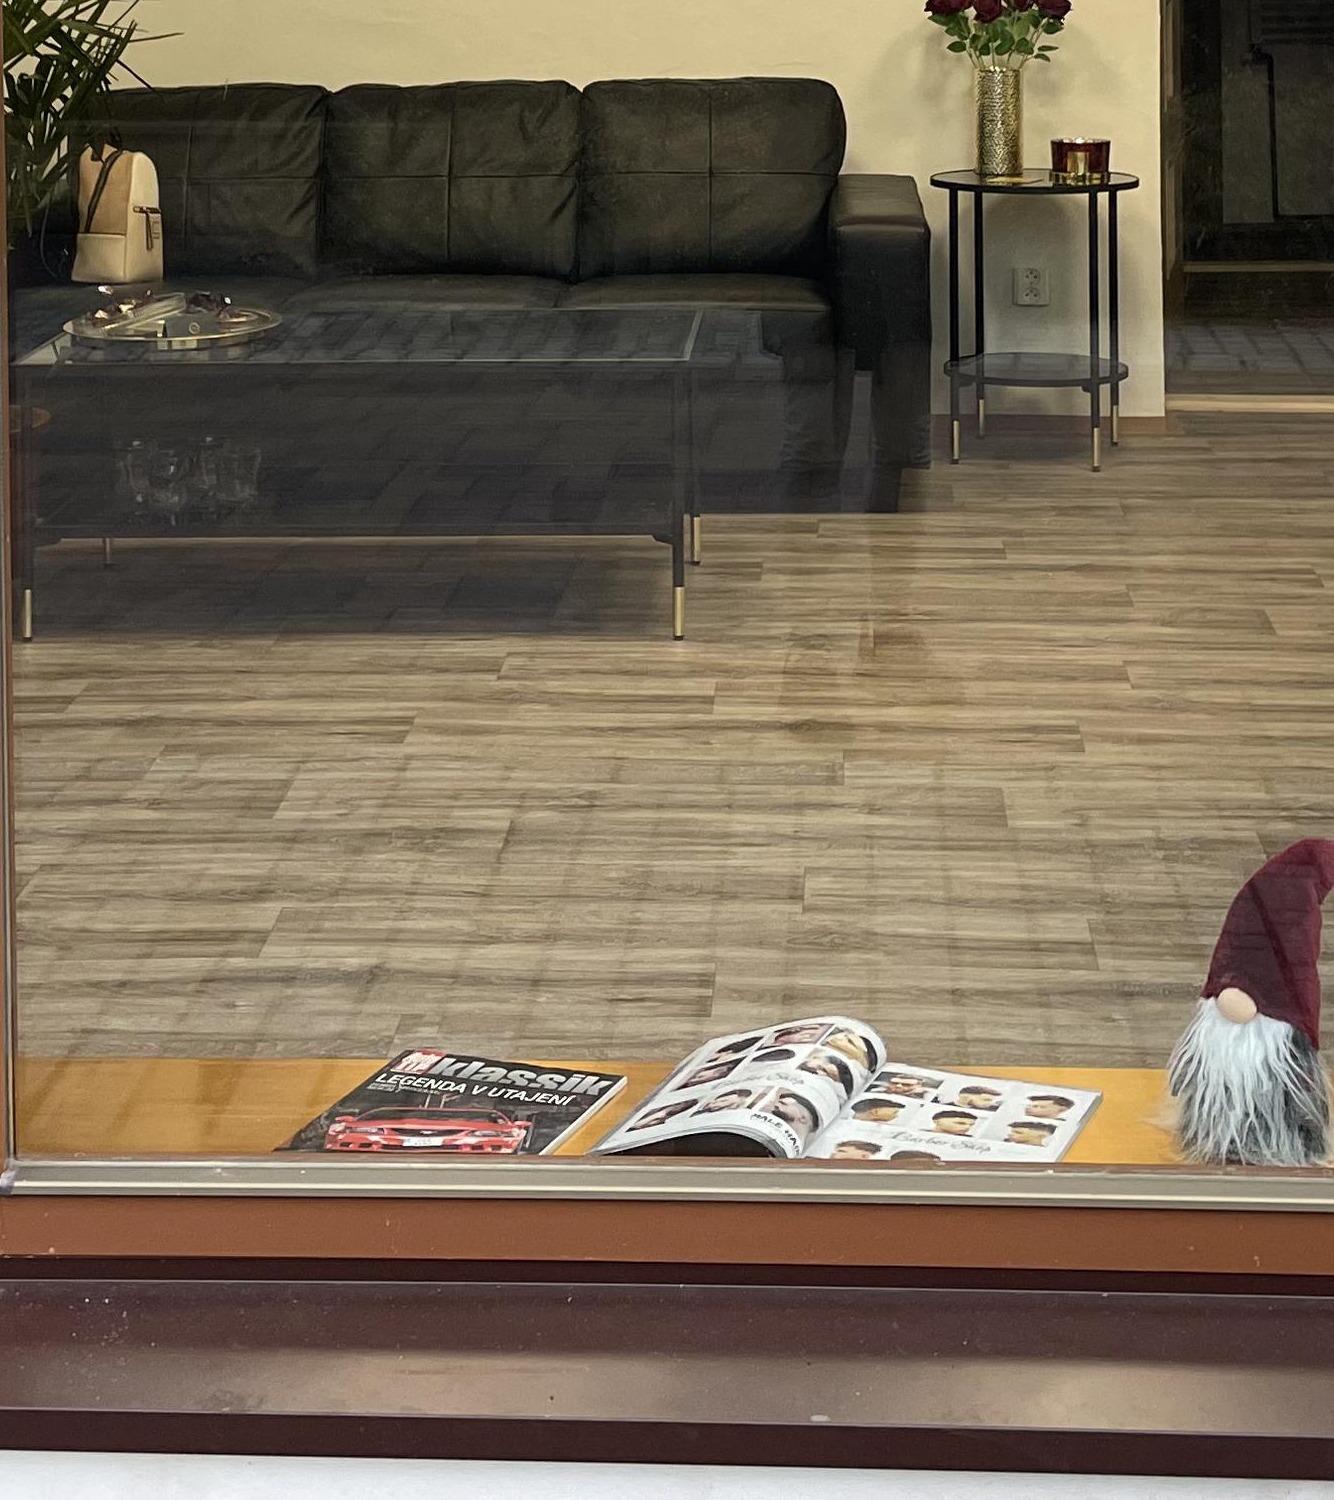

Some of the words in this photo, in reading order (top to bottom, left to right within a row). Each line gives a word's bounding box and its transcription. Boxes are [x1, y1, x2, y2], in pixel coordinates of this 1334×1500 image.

[375, 1073, 467, 1095] LEGENDA
[471, 1085, 487, 1096] V
[488, 1087, 577, 1107] UTAJENÍ
[431, 1057, 614, 1098] klassik
